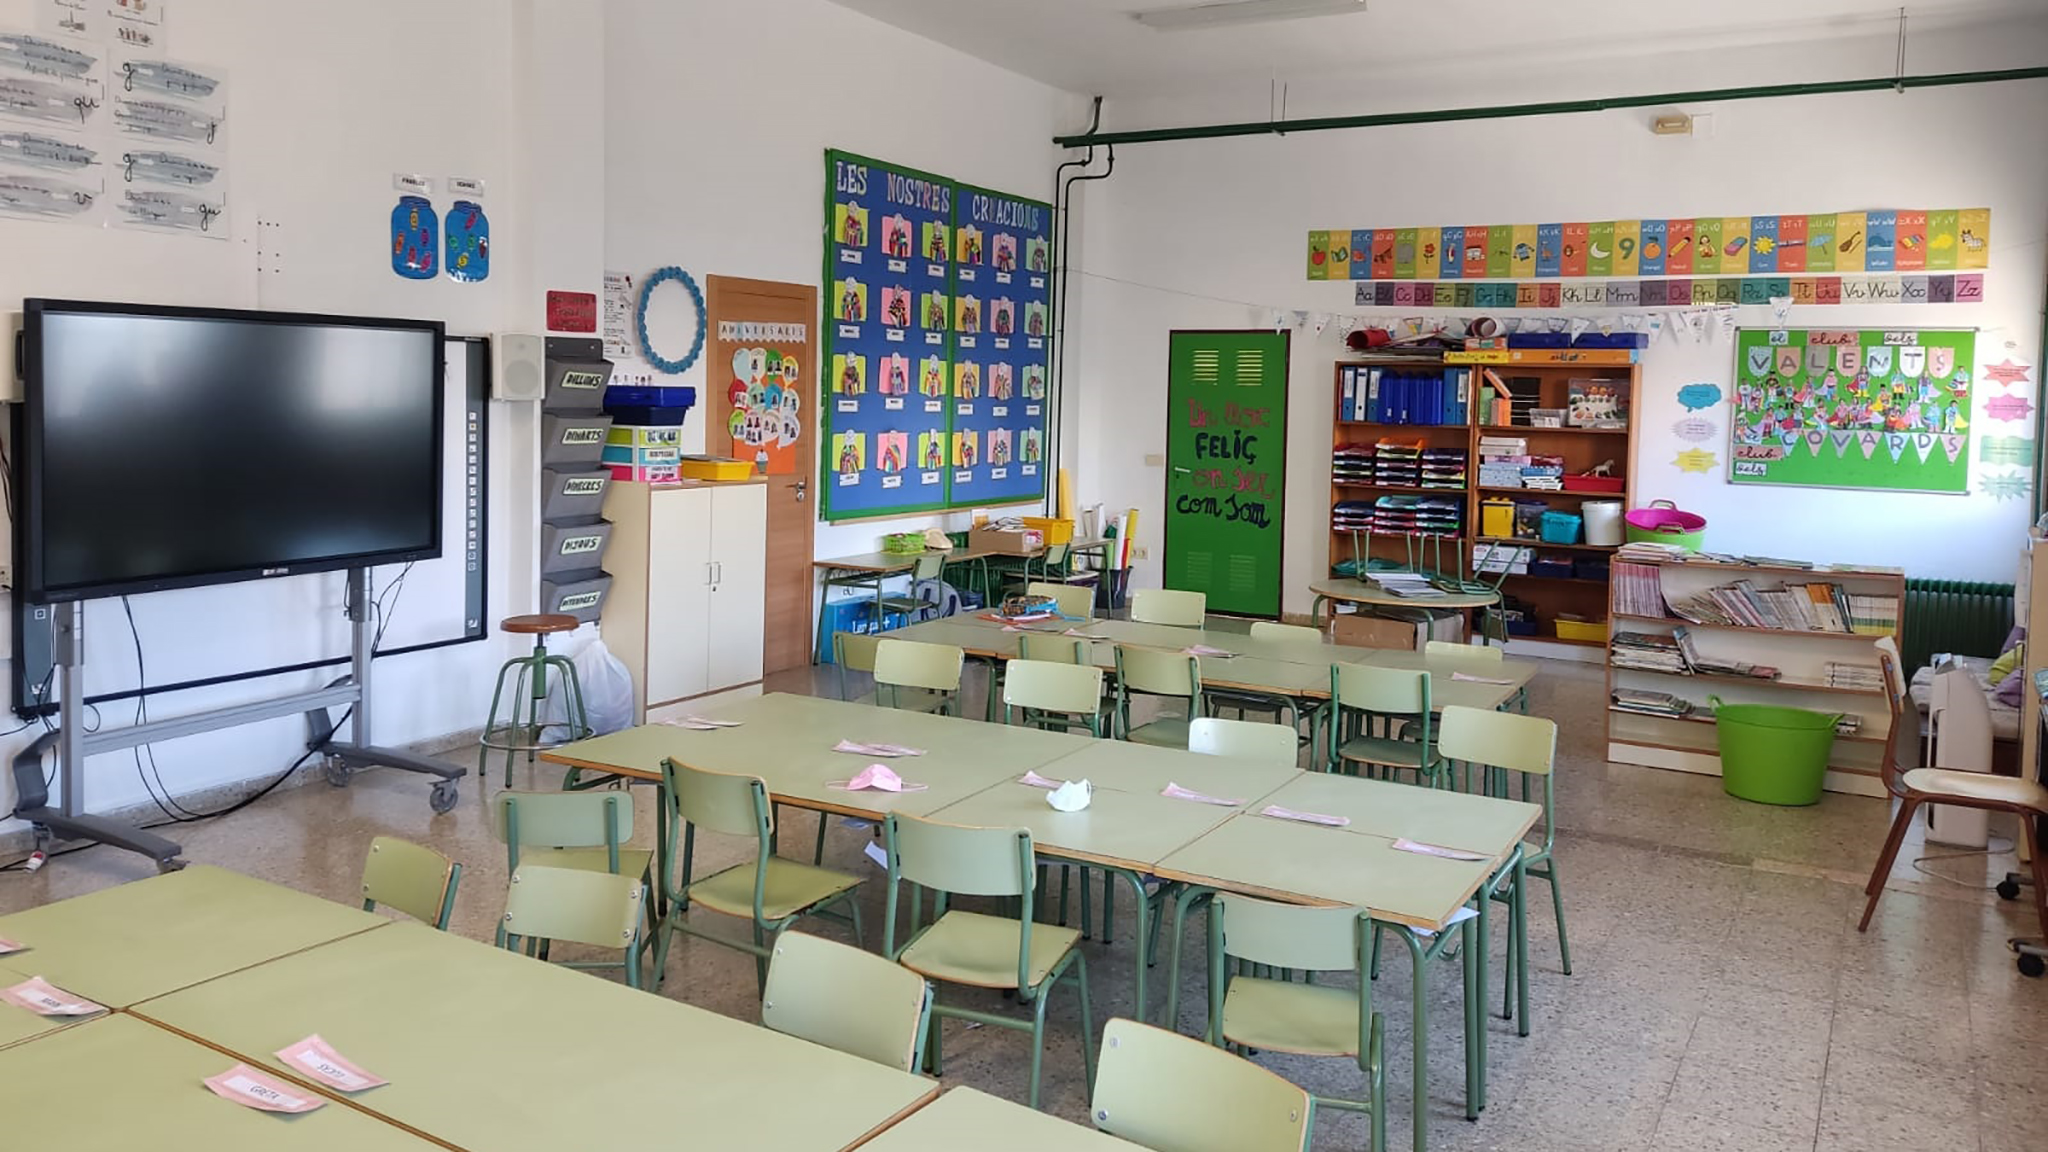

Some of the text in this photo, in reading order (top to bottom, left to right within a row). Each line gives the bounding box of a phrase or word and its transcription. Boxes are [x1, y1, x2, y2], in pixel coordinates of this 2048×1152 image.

[835, 160, 868, 196] LES
[886, 172, 950, 214] NOSTRES
[1750, 351, 1946, 372] VALENTS
[566, 373, 601, 387] DILLUNS
[1781, 428, 1959, 454] COVARDS
[250, 1085, 280, 1100] GRETA
